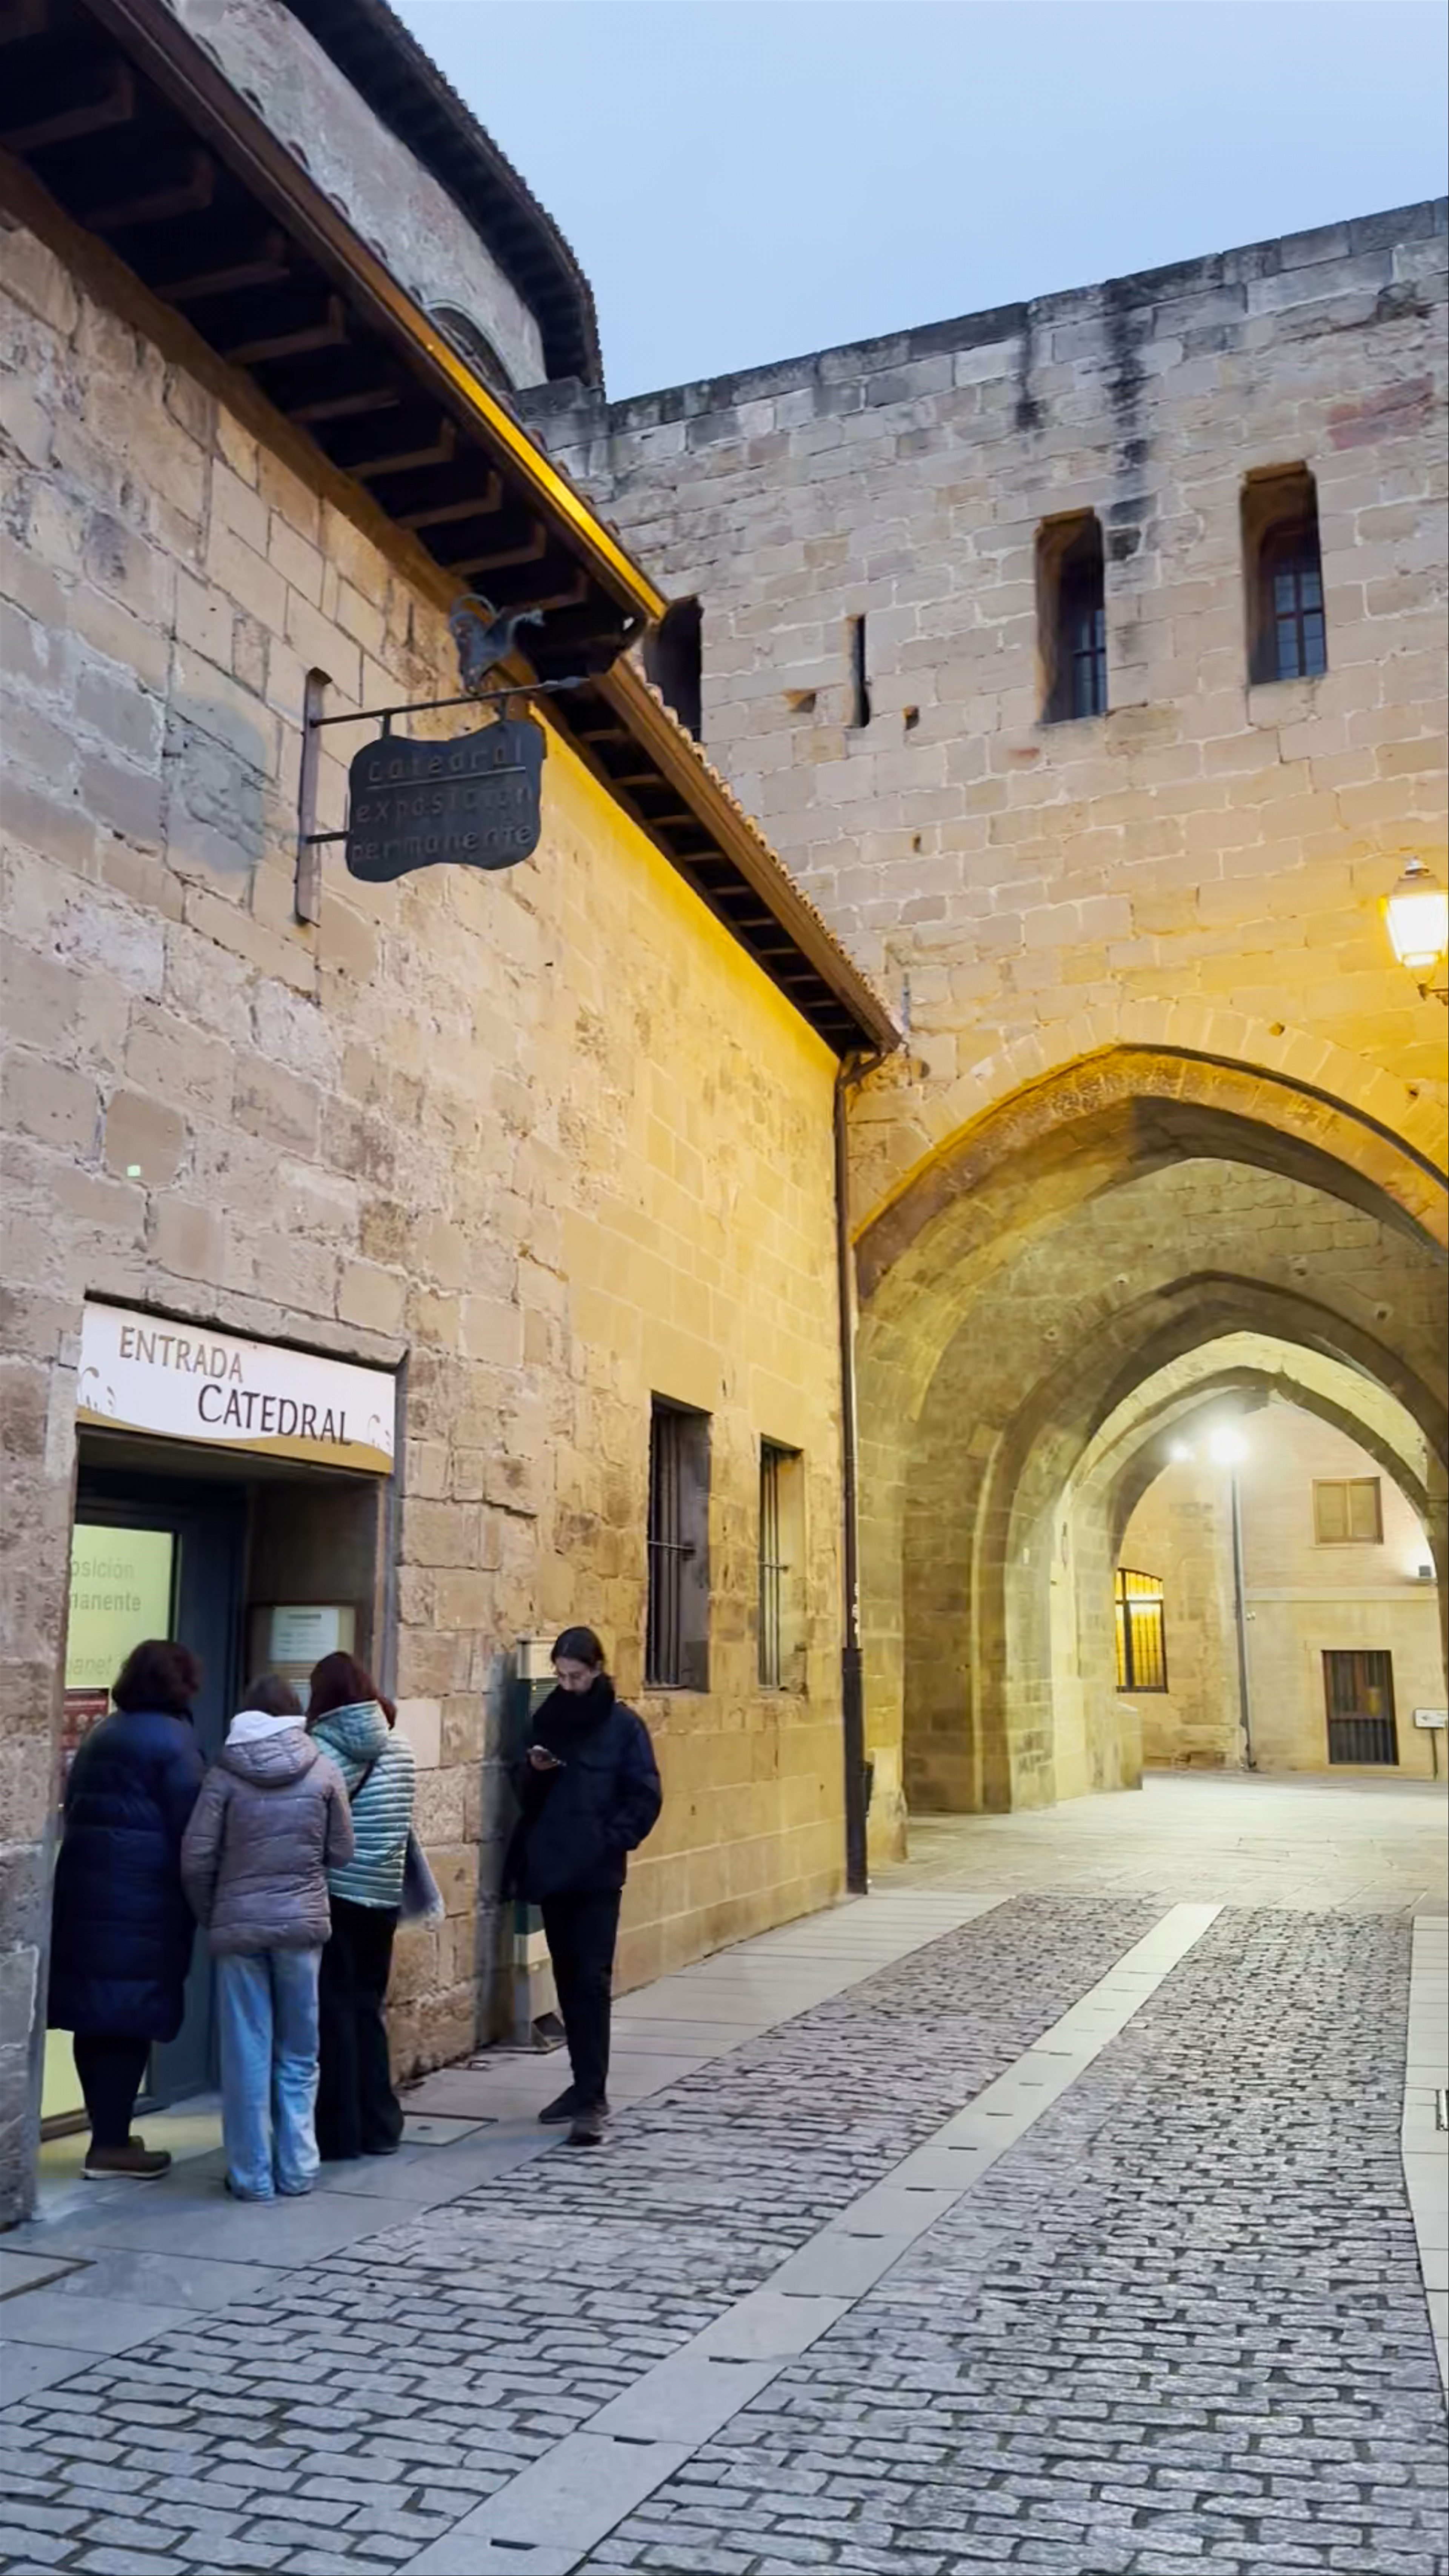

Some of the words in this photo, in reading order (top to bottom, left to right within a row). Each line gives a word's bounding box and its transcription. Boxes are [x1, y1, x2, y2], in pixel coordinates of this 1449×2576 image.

[119, 1326, 243, 1383] ENTRADA
[198, 1383, 351, 1446] CATEDRAL
[71, 1558, 134, 1579] osición
